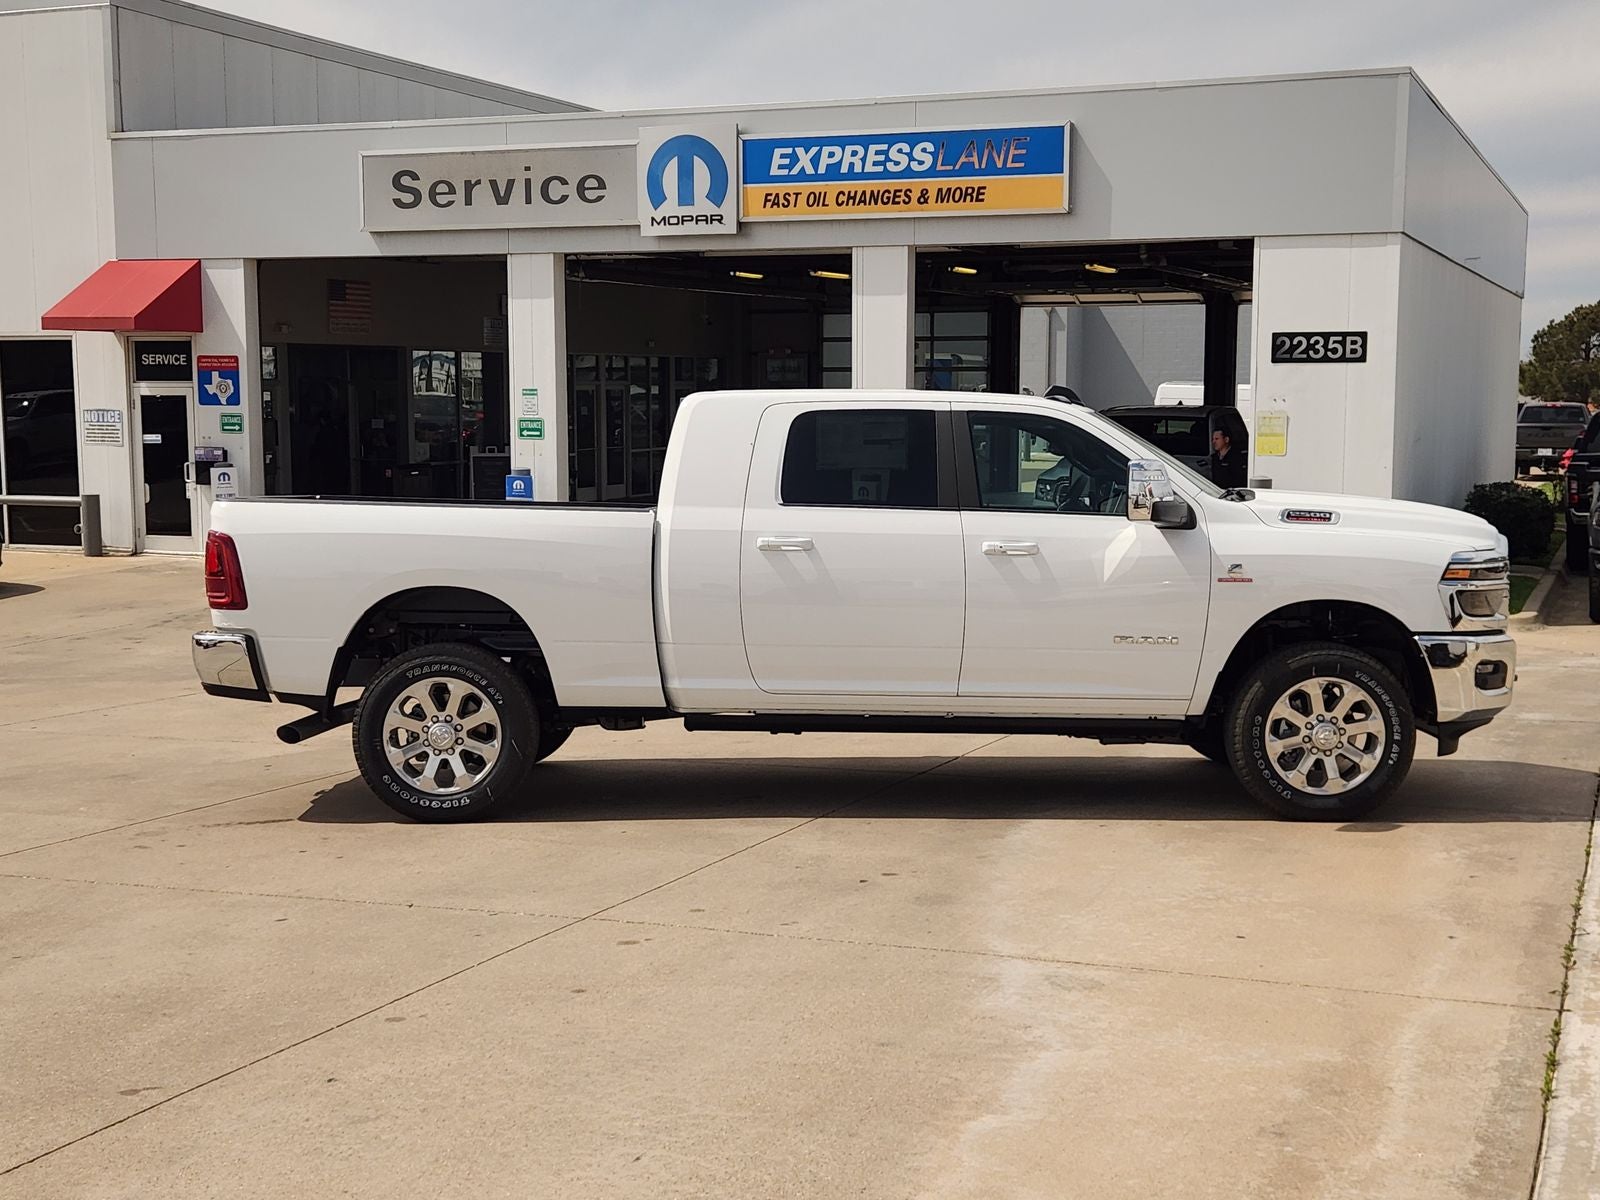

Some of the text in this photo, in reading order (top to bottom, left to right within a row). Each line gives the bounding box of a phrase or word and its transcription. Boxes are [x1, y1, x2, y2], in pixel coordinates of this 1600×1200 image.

[391, 166, 607, 210] Service
[763, 185, 987, 209] FAST OIL CHANGES & MORE
[650, 214, 726, 227] MOPAR
[1275, 335, 1363, 359] 2235B
[141, 353, 188, 365] SERVICE
[84, 410, 120, 422] NOTICE
[222, 416, 242, 424] ENTRANCE
[520, 421, 542, 429] ENTRANCE
[1113, 635, 1179, 645] RAM
